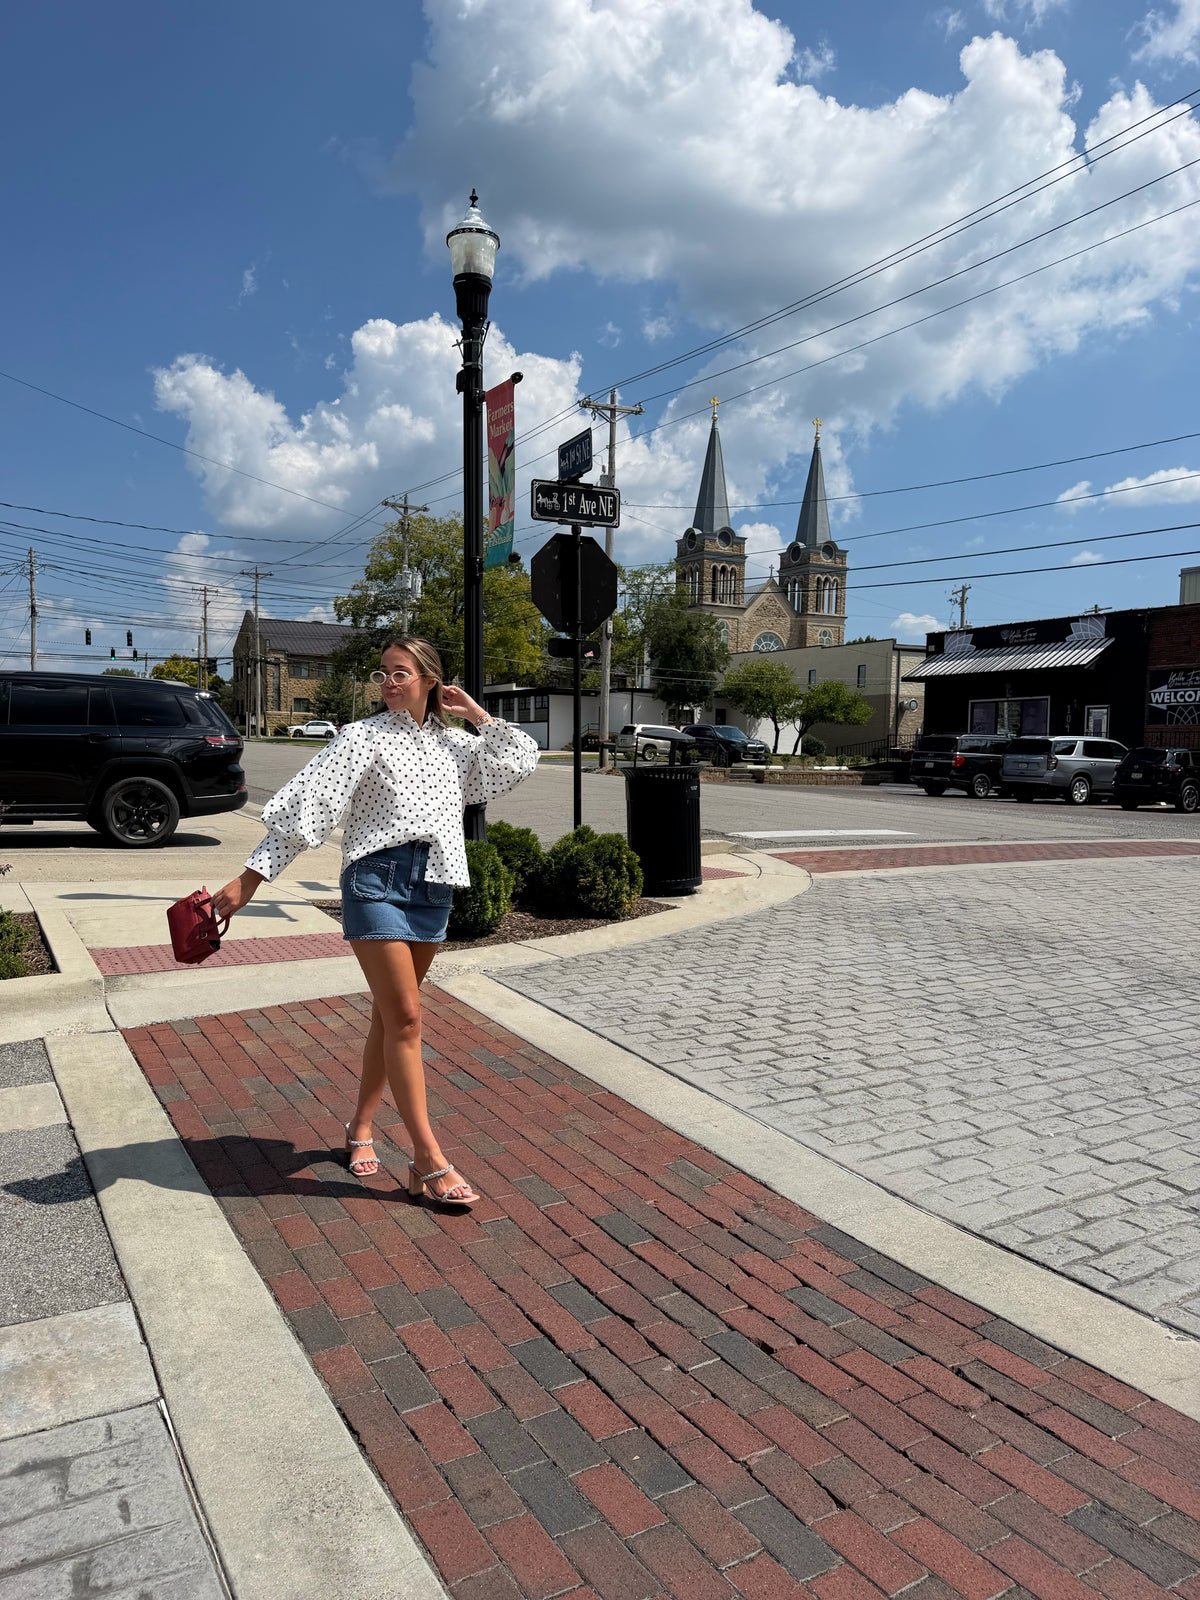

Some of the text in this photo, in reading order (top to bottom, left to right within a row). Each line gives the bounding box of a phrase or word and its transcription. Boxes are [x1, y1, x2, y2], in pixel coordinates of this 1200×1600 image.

[487, 402, 514, 423] Farmers
[490, 419, 512, 440] Market
[582, 438, 590, 462] NE
[562, 492, 614, 517] 1st Ave NE
